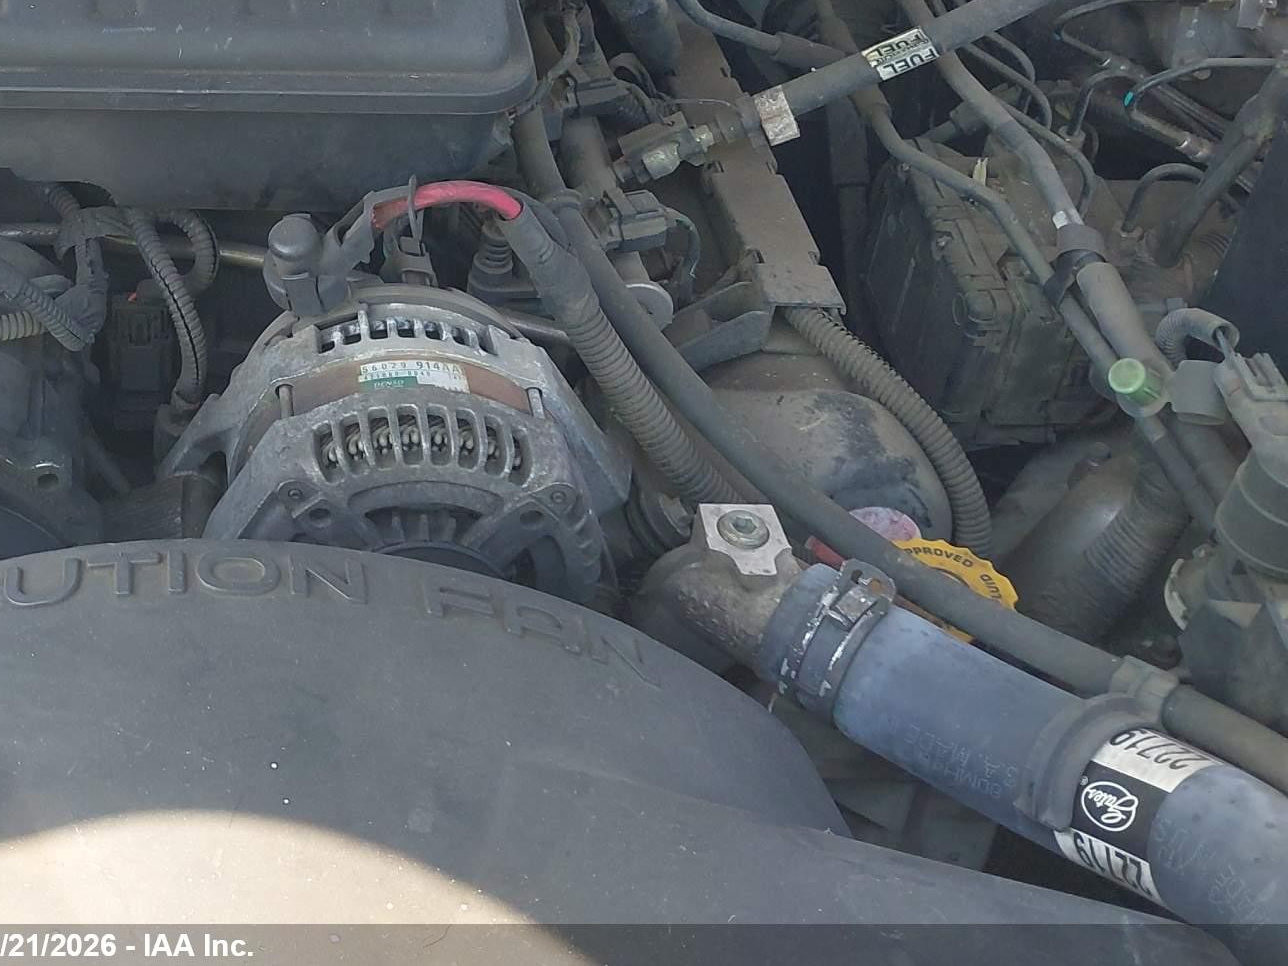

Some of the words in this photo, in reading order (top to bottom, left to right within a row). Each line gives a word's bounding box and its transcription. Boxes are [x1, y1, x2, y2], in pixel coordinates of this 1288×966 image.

[871, 34, 924, 57] FUEL
[882, 47, 939, 74] FUEL
[362, 362, 407, 374] 56029
[421, 578, 664, 689] FAN
[1109, 730, 1209, 770] 22719
[1088, 786, 1140, 825] Gates
[1073, 831, 1154, 897] 22719
